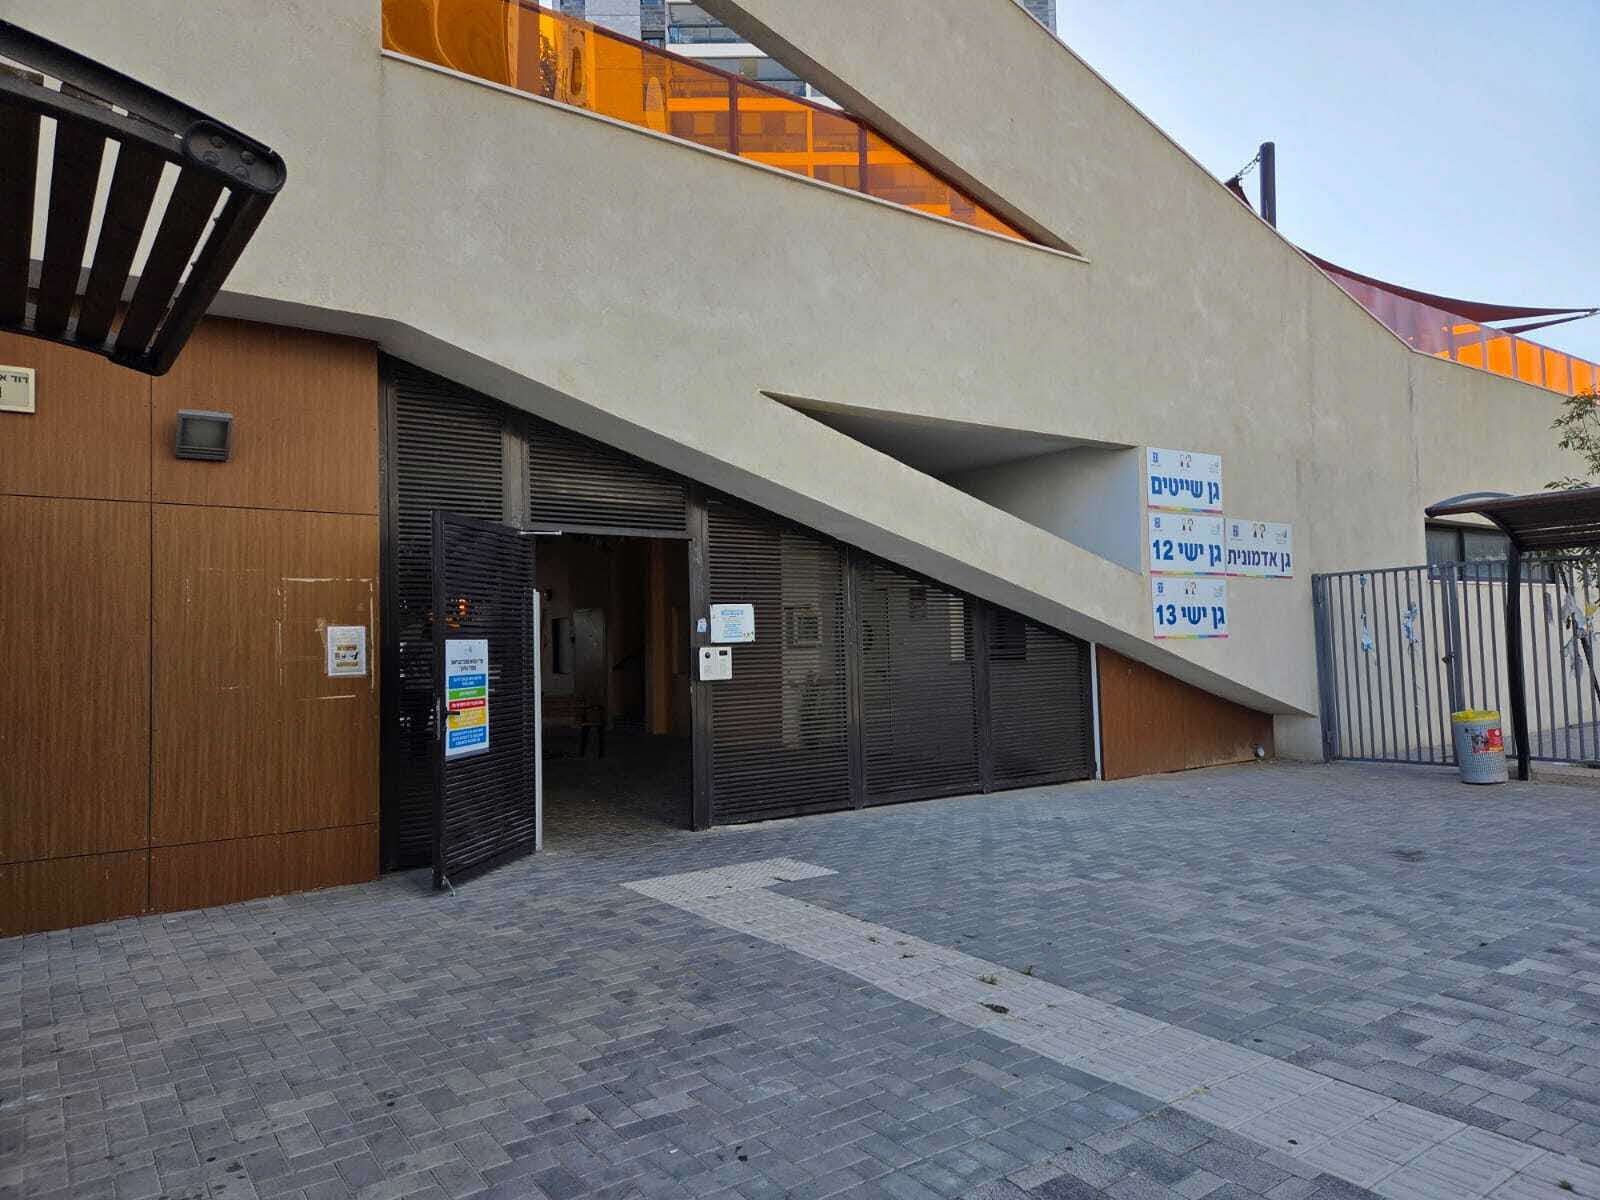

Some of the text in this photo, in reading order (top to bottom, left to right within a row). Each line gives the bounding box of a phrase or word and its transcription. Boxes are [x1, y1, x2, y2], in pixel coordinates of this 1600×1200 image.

[1151, 475, 1220, 504] גן שייטים
[1152, 539, 1222, 567] גן ישי 12
[1227, 548, 1292, 572] גן אדמונית
[1156, 603, 1226, 630] גן ישי 13
